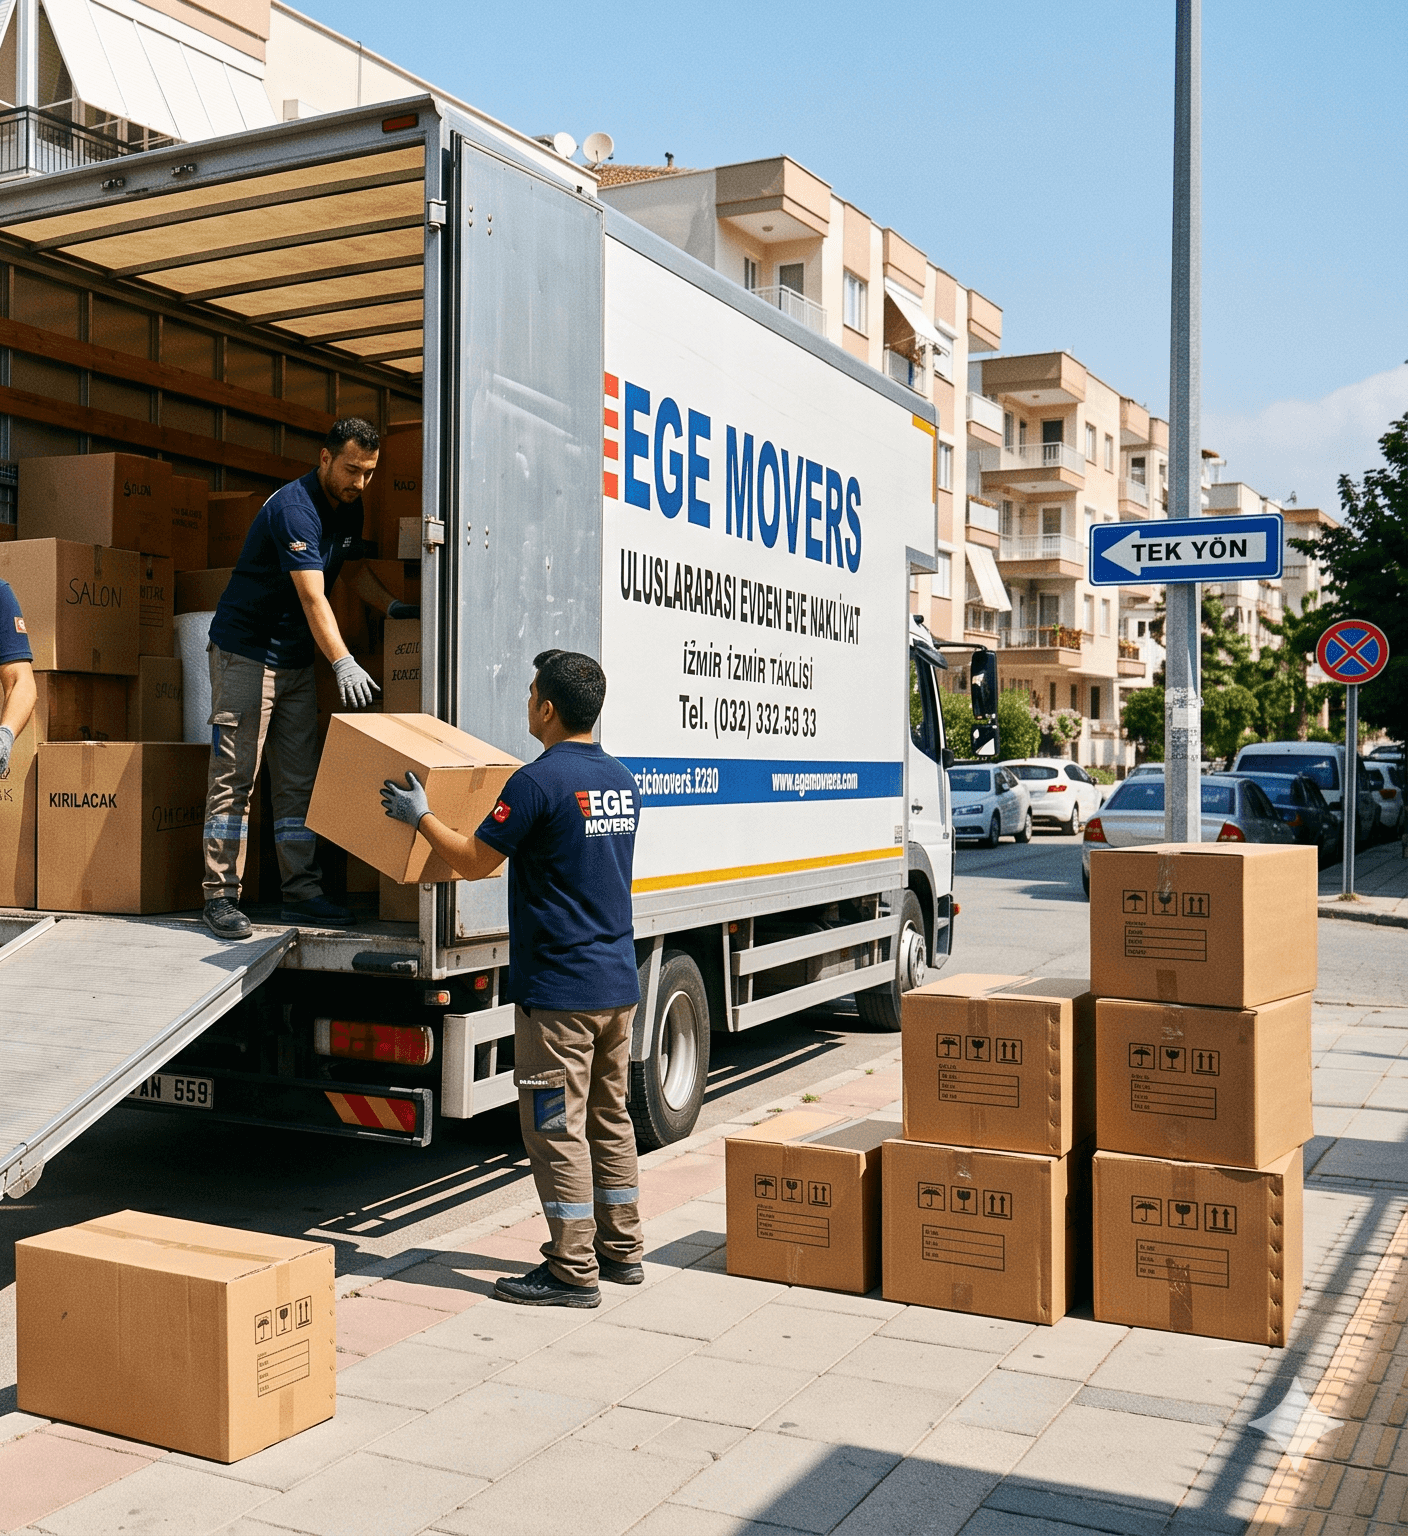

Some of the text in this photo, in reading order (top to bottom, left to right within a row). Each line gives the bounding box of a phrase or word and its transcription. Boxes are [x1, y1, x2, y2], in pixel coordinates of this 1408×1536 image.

[624, 380, 862, 574] EGE MOVERS
[1131, 536, 1247, 562] TEK YÖN
[65, 577, 122, 609] SALON
[620, 548, 861, 645] ULUSLARARASI EVDEN EVE NAKLİYAT
[679, 694, 708, 730] Tel.
[714, 697, 752, 740] (032)
[49, 792, 117, 809] KIRILACAK
[589, 789, 635, 817] EGE
[585, 817, 636, 835] MOVERS
[131, 1076, 208, 1104] AN 559
